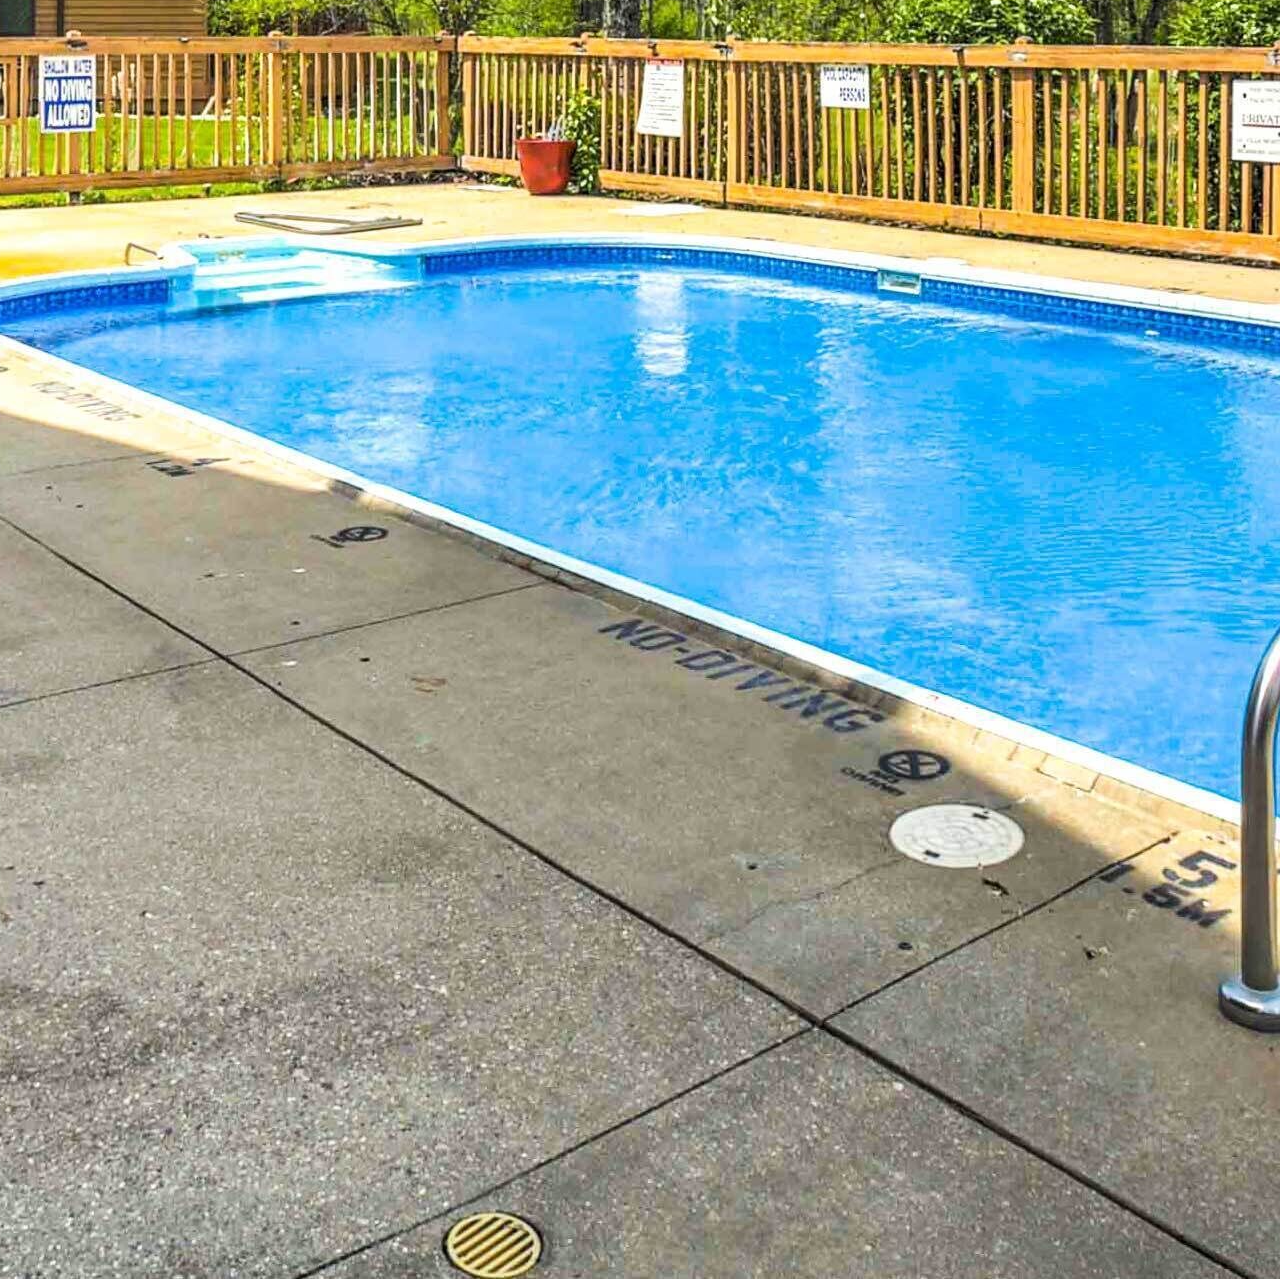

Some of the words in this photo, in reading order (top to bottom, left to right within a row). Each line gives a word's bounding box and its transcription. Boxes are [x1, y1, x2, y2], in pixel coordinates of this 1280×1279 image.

[44, 59, 69, 74] SHALLOW
[74, 59, 92, 73] WATER
[45, 79, 59, 102] NO
[60, 78, 92, 102] DIVING
[839, 87, 866, 103] PERSONS
[47, 103, 91, 127] ALLOWED
[598, 619, 887, 733] NO-DIVING
[1162, 850, 1237, 889] 5
